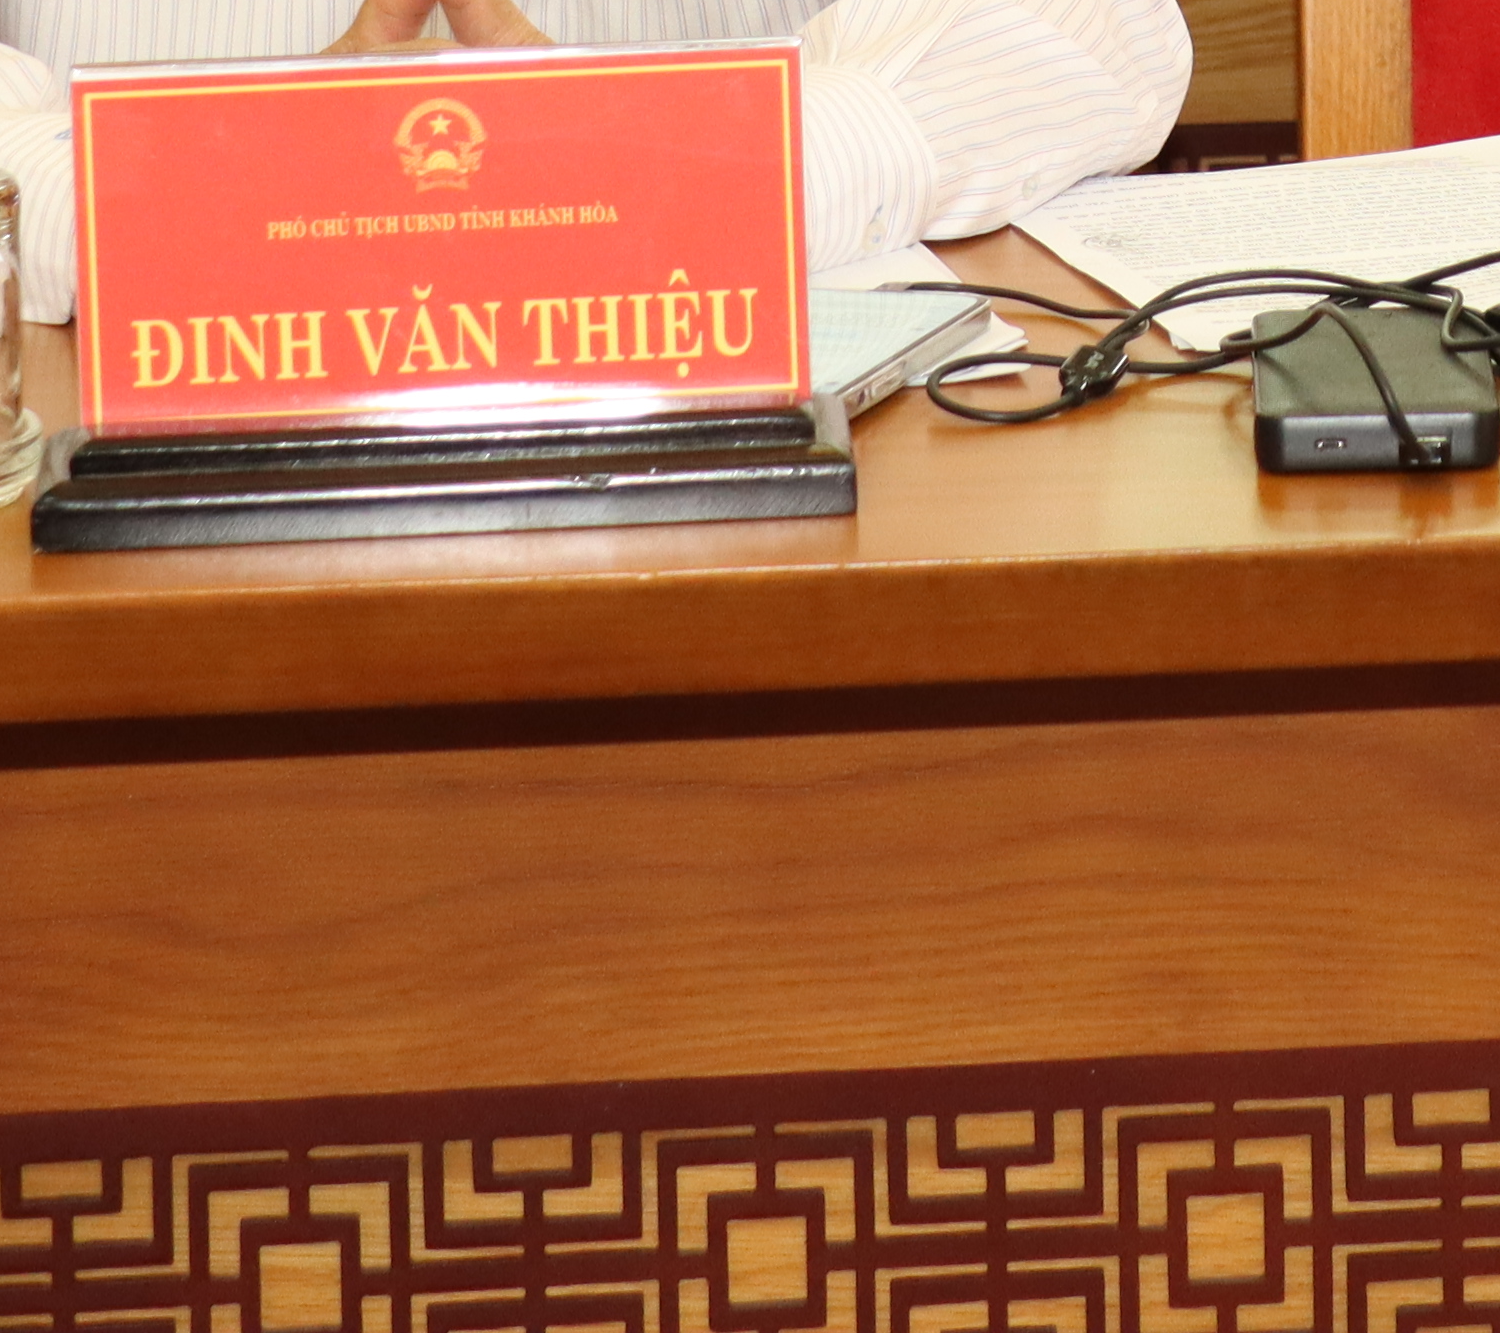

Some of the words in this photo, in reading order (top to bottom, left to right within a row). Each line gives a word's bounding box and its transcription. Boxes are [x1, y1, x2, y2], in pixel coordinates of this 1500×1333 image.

[266, 215, 308, 241] PHÓ
[310, 210, 351, 238] CHỦ
[354, 214, 400, 240] TỊCH
[402, 211, 457, 234] UBND
[459, 204, 506, 231] TỈNH
[509, 202, 576, 229] KHÁNH
[578, 199, 620, 226] HÒA
[130, 309, 329, 389] ĐINH
[346, 281, 503, 376] VĂN
[521, 267, 758, 378] THIỆU
